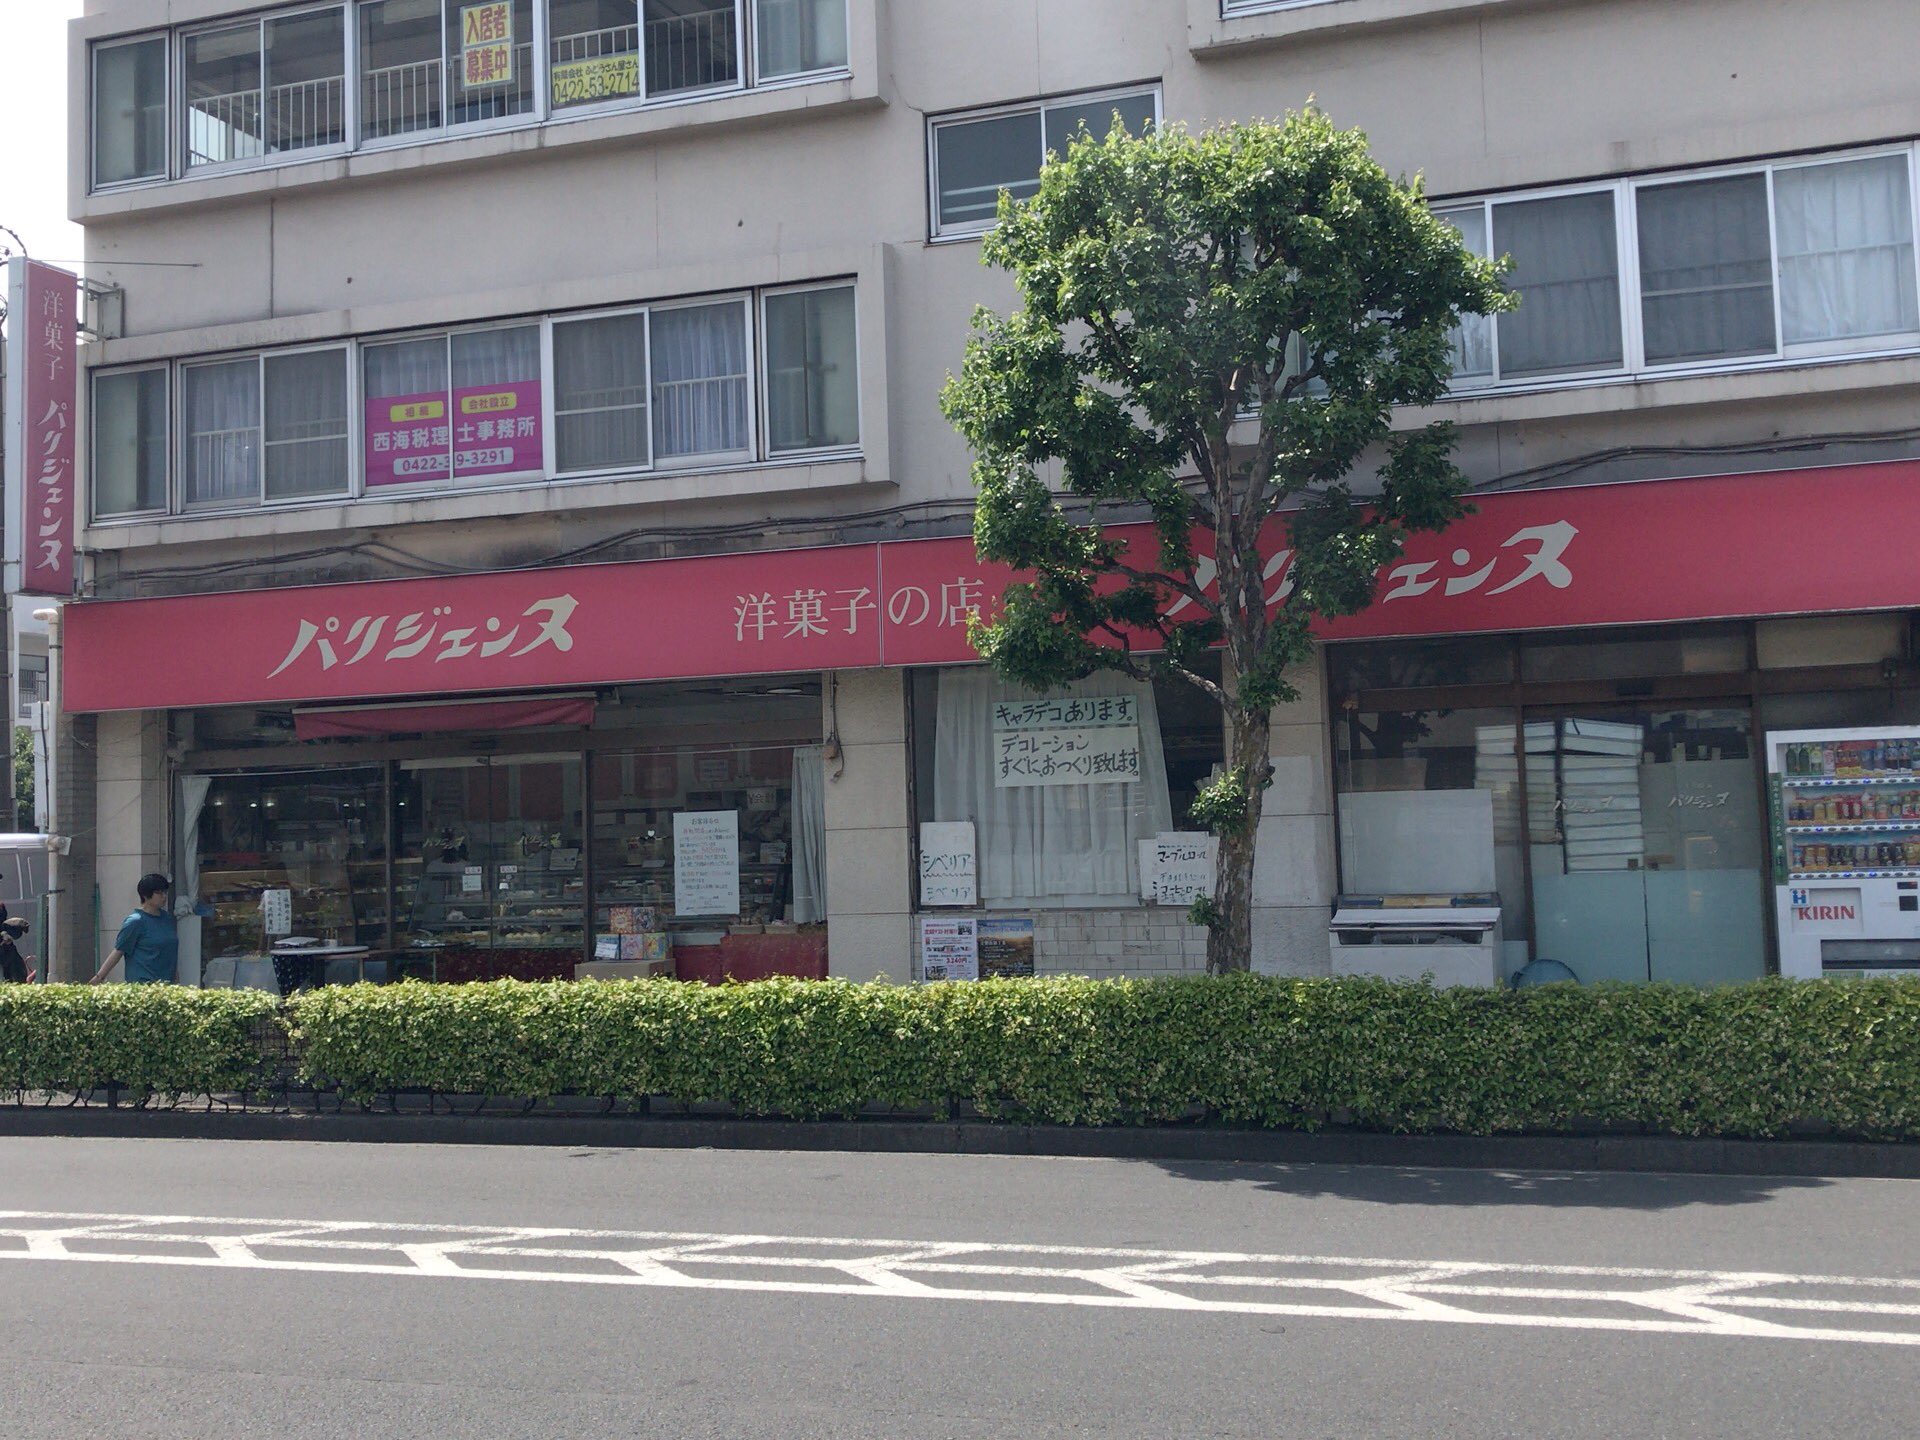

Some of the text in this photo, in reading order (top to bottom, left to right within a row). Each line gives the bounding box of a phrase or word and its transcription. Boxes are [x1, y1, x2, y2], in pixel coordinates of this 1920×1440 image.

[465, 5, 507, 44] 入居者
[465, 45, 507, 83] 募集中
[553, 70, 640, 104] 0422-53-2714
[468, 396, 510, 410] 会社設立
[35, 289, 71, 572] 洋菓子 パリジェンヌ
[402, 450, 505, 472] 0422-39-3291
[733, 576, 984, 642] 洋菓子の店
[266, 593, 580, 680] パリジェンヌ
[1001, 733, 1090, 755] デコレーション
[1798, 905, 1855, 920] KIRIN
